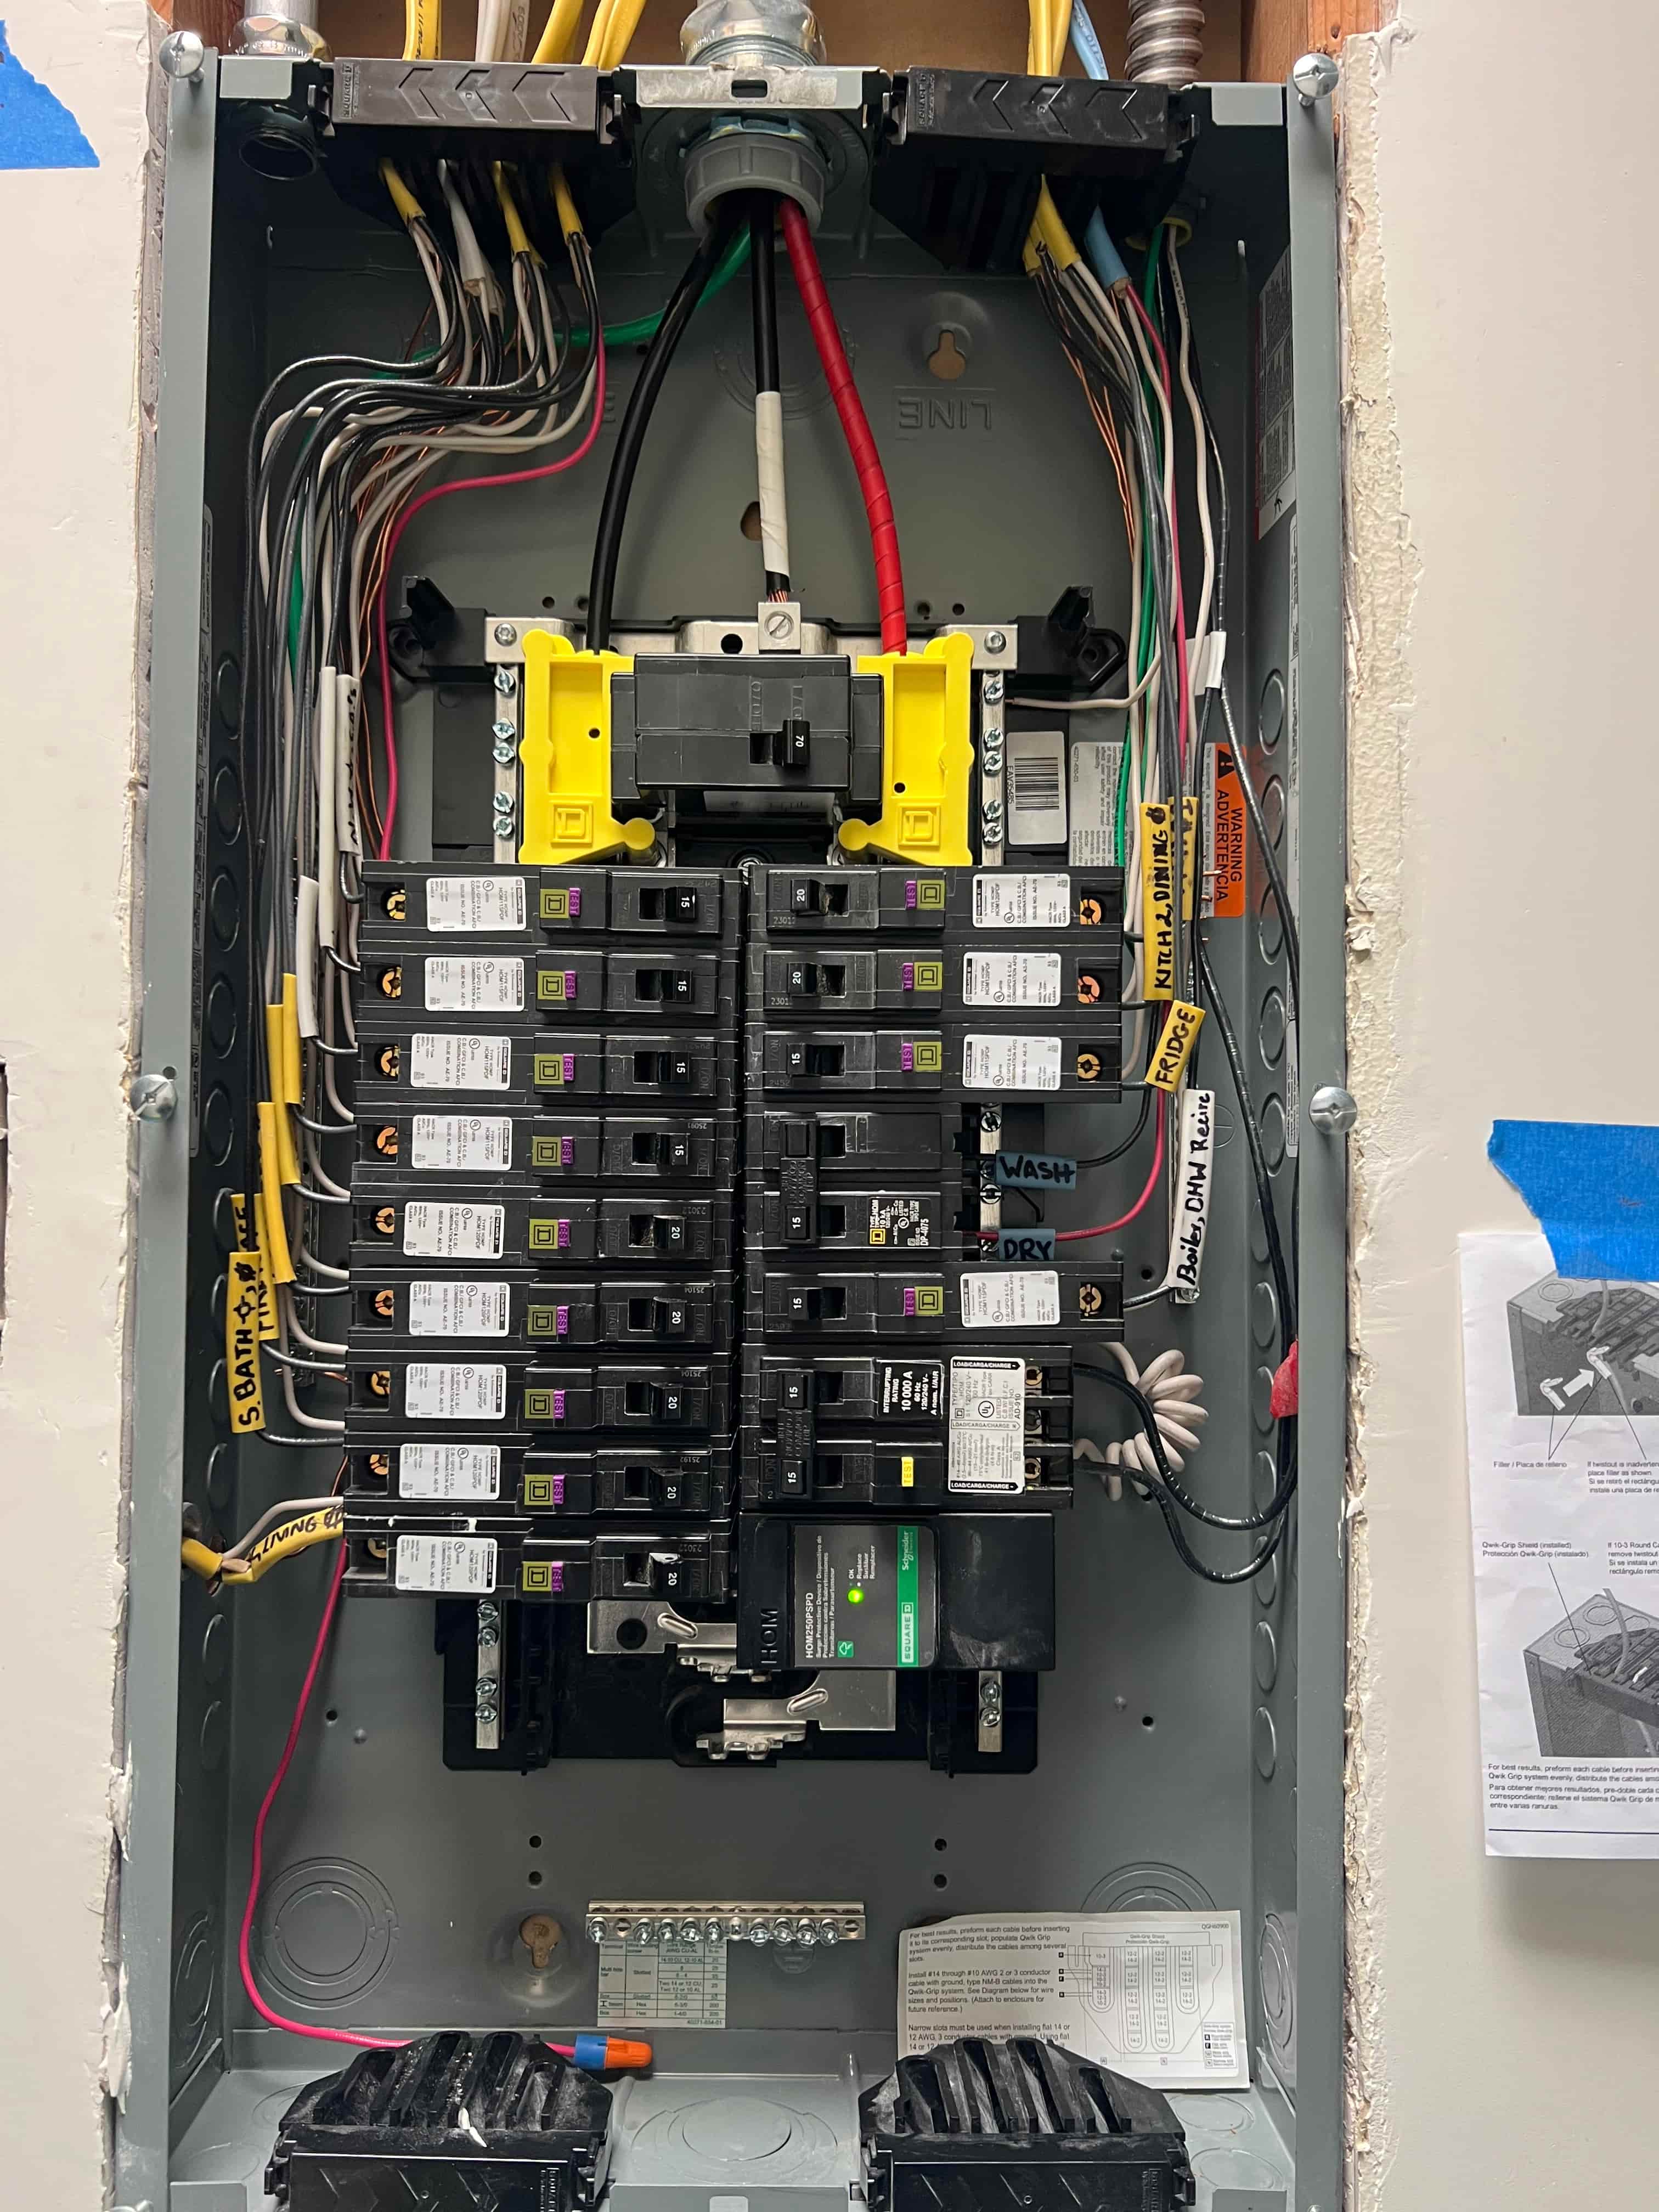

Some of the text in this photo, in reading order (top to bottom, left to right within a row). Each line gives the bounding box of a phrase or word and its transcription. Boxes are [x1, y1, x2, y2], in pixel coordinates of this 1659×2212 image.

[795, 735, 804, 747] 70
[1216, 789, 1229, 901] ADVERTENCIA
[1231, 808, 1243, 882] WARNING
[1153, 830, 1171, 900] DINING
[569, 890, 579, 913] TEST
[681, 896, 690, 908] 15
[797, 888, 805, 901] 20
[906, 881, 916, 906] TEST
[566, 973, 575, 996] TEST
[678, 980, 686, 991] 15
[793, 972, 801, 984] 20
[904, 964, 913, 991] TEST
[903, 1043, 913, 1070] TEST
[1154, 1007, 1195, 1083] FRIDGE
[563, 1056, 573, 1080] TEST
[676, 1062, 685, 1073] 15
[792, 1053, 800, 1064] 15
[562, 1139, 571, 1163] TEST
[675, 1144, 684, 1156] 15
[999, 1155, 1076, 1184] WASH
[1184, 1161, 1206, 1212] DHW
[672, 1227, 680, 1239] 20
[793, 1217, 800, 1228] 15
[558, 1223, 567, 1246] TEST
[1003, 1238, 1052, 1261] DRY
[793, 1297, 802, 1308] 15
[905, 1289, 914, 1314] TEST
[558, 1308, 567, 1334] TEST
[672, 1311, 681, 1324] 20
[233, 1329, 256, 1401] BATH
[789, 1386, 798, 1398] 15
[883, 1367, 893, 1413] INTERRUPTING
[902, 1370, 913, 1411] 10 000 A
[914, 1382, 921, 1401] 60 Hz
[555, 1394, 565, 1419] TEST
[668, 1396, 678, 1409] 20
[788, 1471, 796, 1483] 15
[903, 1459, 912, 1483] TEST
[667, 1487, 676, 1499] 20
[262, 1516, 317, 1554] LIVING
[668, 1572, 677, 1585] 20
[849, 1568, 854, 1578] OK
[760, 1611, 778, 1663] HOM
